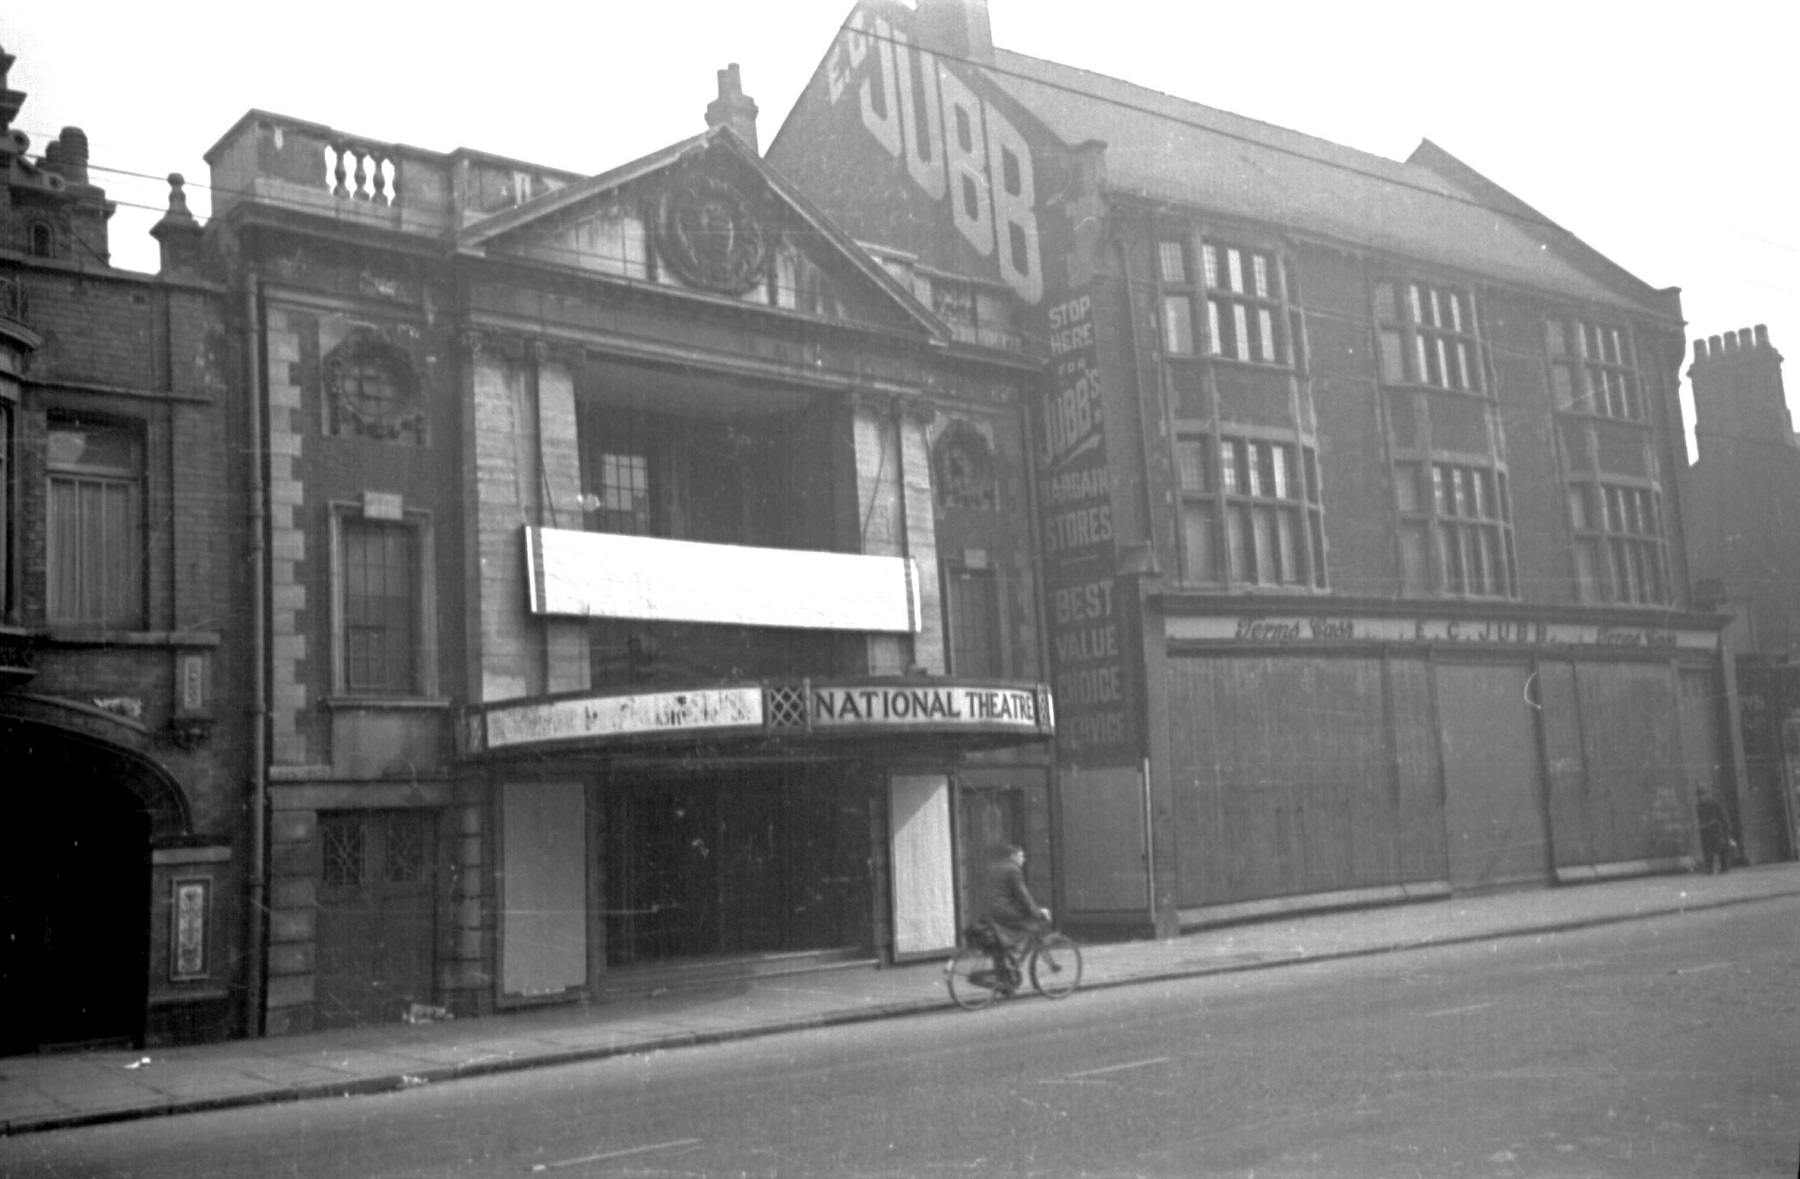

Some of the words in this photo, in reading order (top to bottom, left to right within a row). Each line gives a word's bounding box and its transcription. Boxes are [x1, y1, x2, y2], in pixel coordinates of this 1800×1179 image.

[859, 16, 1043, 304] JUBB
[1049, 295, 1091, 330] STOP
[1051, 323, 1093, 355] HERE
[1046, 504, 1113, 552] STORES
[1056, 579, 1115, 624] BEST
[1055, 626, 1118, 663] VALUE
[1057, 665, 1123, 706] CHOICE
[815, 691, 962, 720] NATIONAL
[965, 691, 1036, 720] THEATRE
